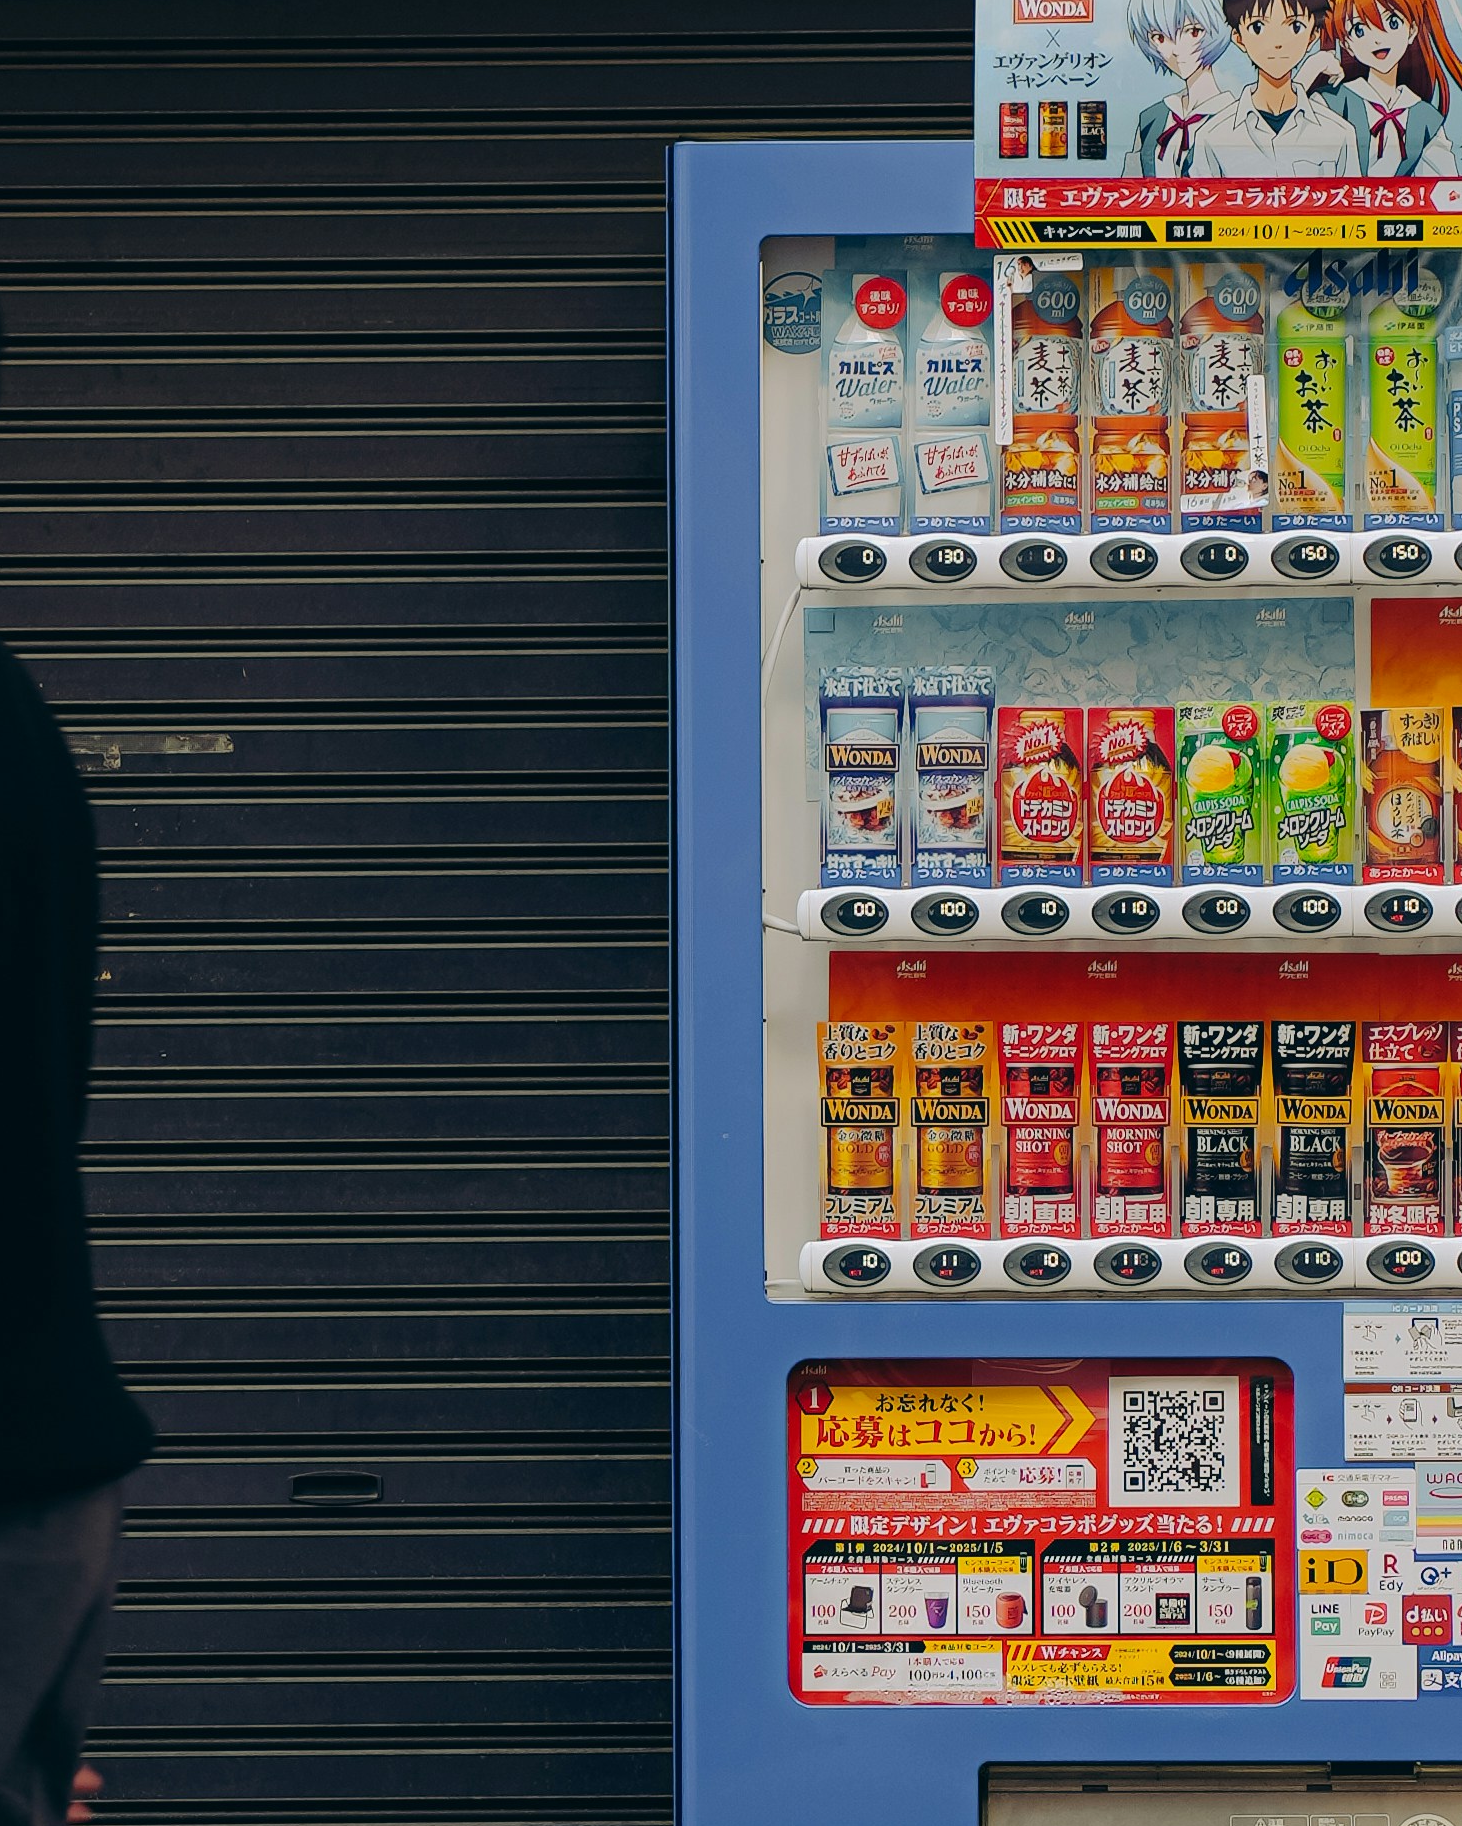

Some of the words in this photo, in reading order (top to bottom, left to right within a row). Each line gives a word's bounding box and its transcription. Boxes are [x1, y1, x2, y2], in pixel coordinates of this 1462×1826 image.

[993, 53, 1114, 70] エヴァンゲリオン
[1006, 72, 1100, 89] キャンペーン
[1002, 188, 1047, 209] 限定
[1043, 225, 1142, 239] キャンペーン期間
[1172, 225, 1205, 238] 第1弾
[1383, 224, 1417, 238] 第2弾
[1284, 247, 1419, 298] Asahi
[1037, 291, 1076, 308] 600
[1218, 289, 1256, 306] 600
[838, 361, 896, 376] カルピス
[926, 358, 983, 374] カルピス
[1028, 342, 1056, 409] 麦茶
[836, 377, 898, 399] Water
[923, 375, 985, 397] Water
[823, 678, 901, 698] 氷点下仕立て
[1399, 714, 1440, 730] すっきり
[1400, 731, 1440, 747] 香ばしい
[829, 745, 894, 766] WONDA
[1020, 800, 1073, 818] ドデカミン
[1022, 818, 1071, 837] ストロング
[1186, 810, 1253, 840] メロンクリーム
[823, 1024, 869, 1042] 上質な
[1368, 1023, 1444, 1041] エスプレッソ
[823, 1042, 896, 1061] 香りとコク
[1003, 1046, 1078, 1059] モーニングアロマ
[1183, 1046, 1259, 1059] モーニングアロマ
[1368, 1042, 1414, 1061] 仕立て
[826, 1099, 893, 1121] WONDA
[1007, 1099, 1073, 1121] WONDA
[1096, 1099, 1164, 1121] WONDA
[1188, 1099, 1254, 1121] WONDA
[1374, 1099, 1440, 1120] WONDA
[1016, 1127, 1071, 1140] MORNING
[838, 1144, 874, 1154] GOLD
[1016, 1140, 1050, 1153] SHOT
[1196, 1136, 1249, 1153] BLACK
[825, 1196, 895, 1214] プレミアム
[1186, 1195, 1255, 1222] 朝専用
[1338, 1530, 1373, 1540] nimoca
[1305, 1557, 1363, 1585] iD
[1379, 1580, 1403, 1592] Edy
[811, 1605, 836, 1618] 100
[889, 1605, 917, 1618] 200
[966, 1605, 991, 1618] 150
[1311, 1604, 1339, 1614] LINE
[1406, 1605, 1448, 1622] d払い
[1314, 1620, 1338, 1633] Pay
[1358, 1627, 1395, 1637] PayPay
[1041, 1646, 1103, 1660] Wチャンス
